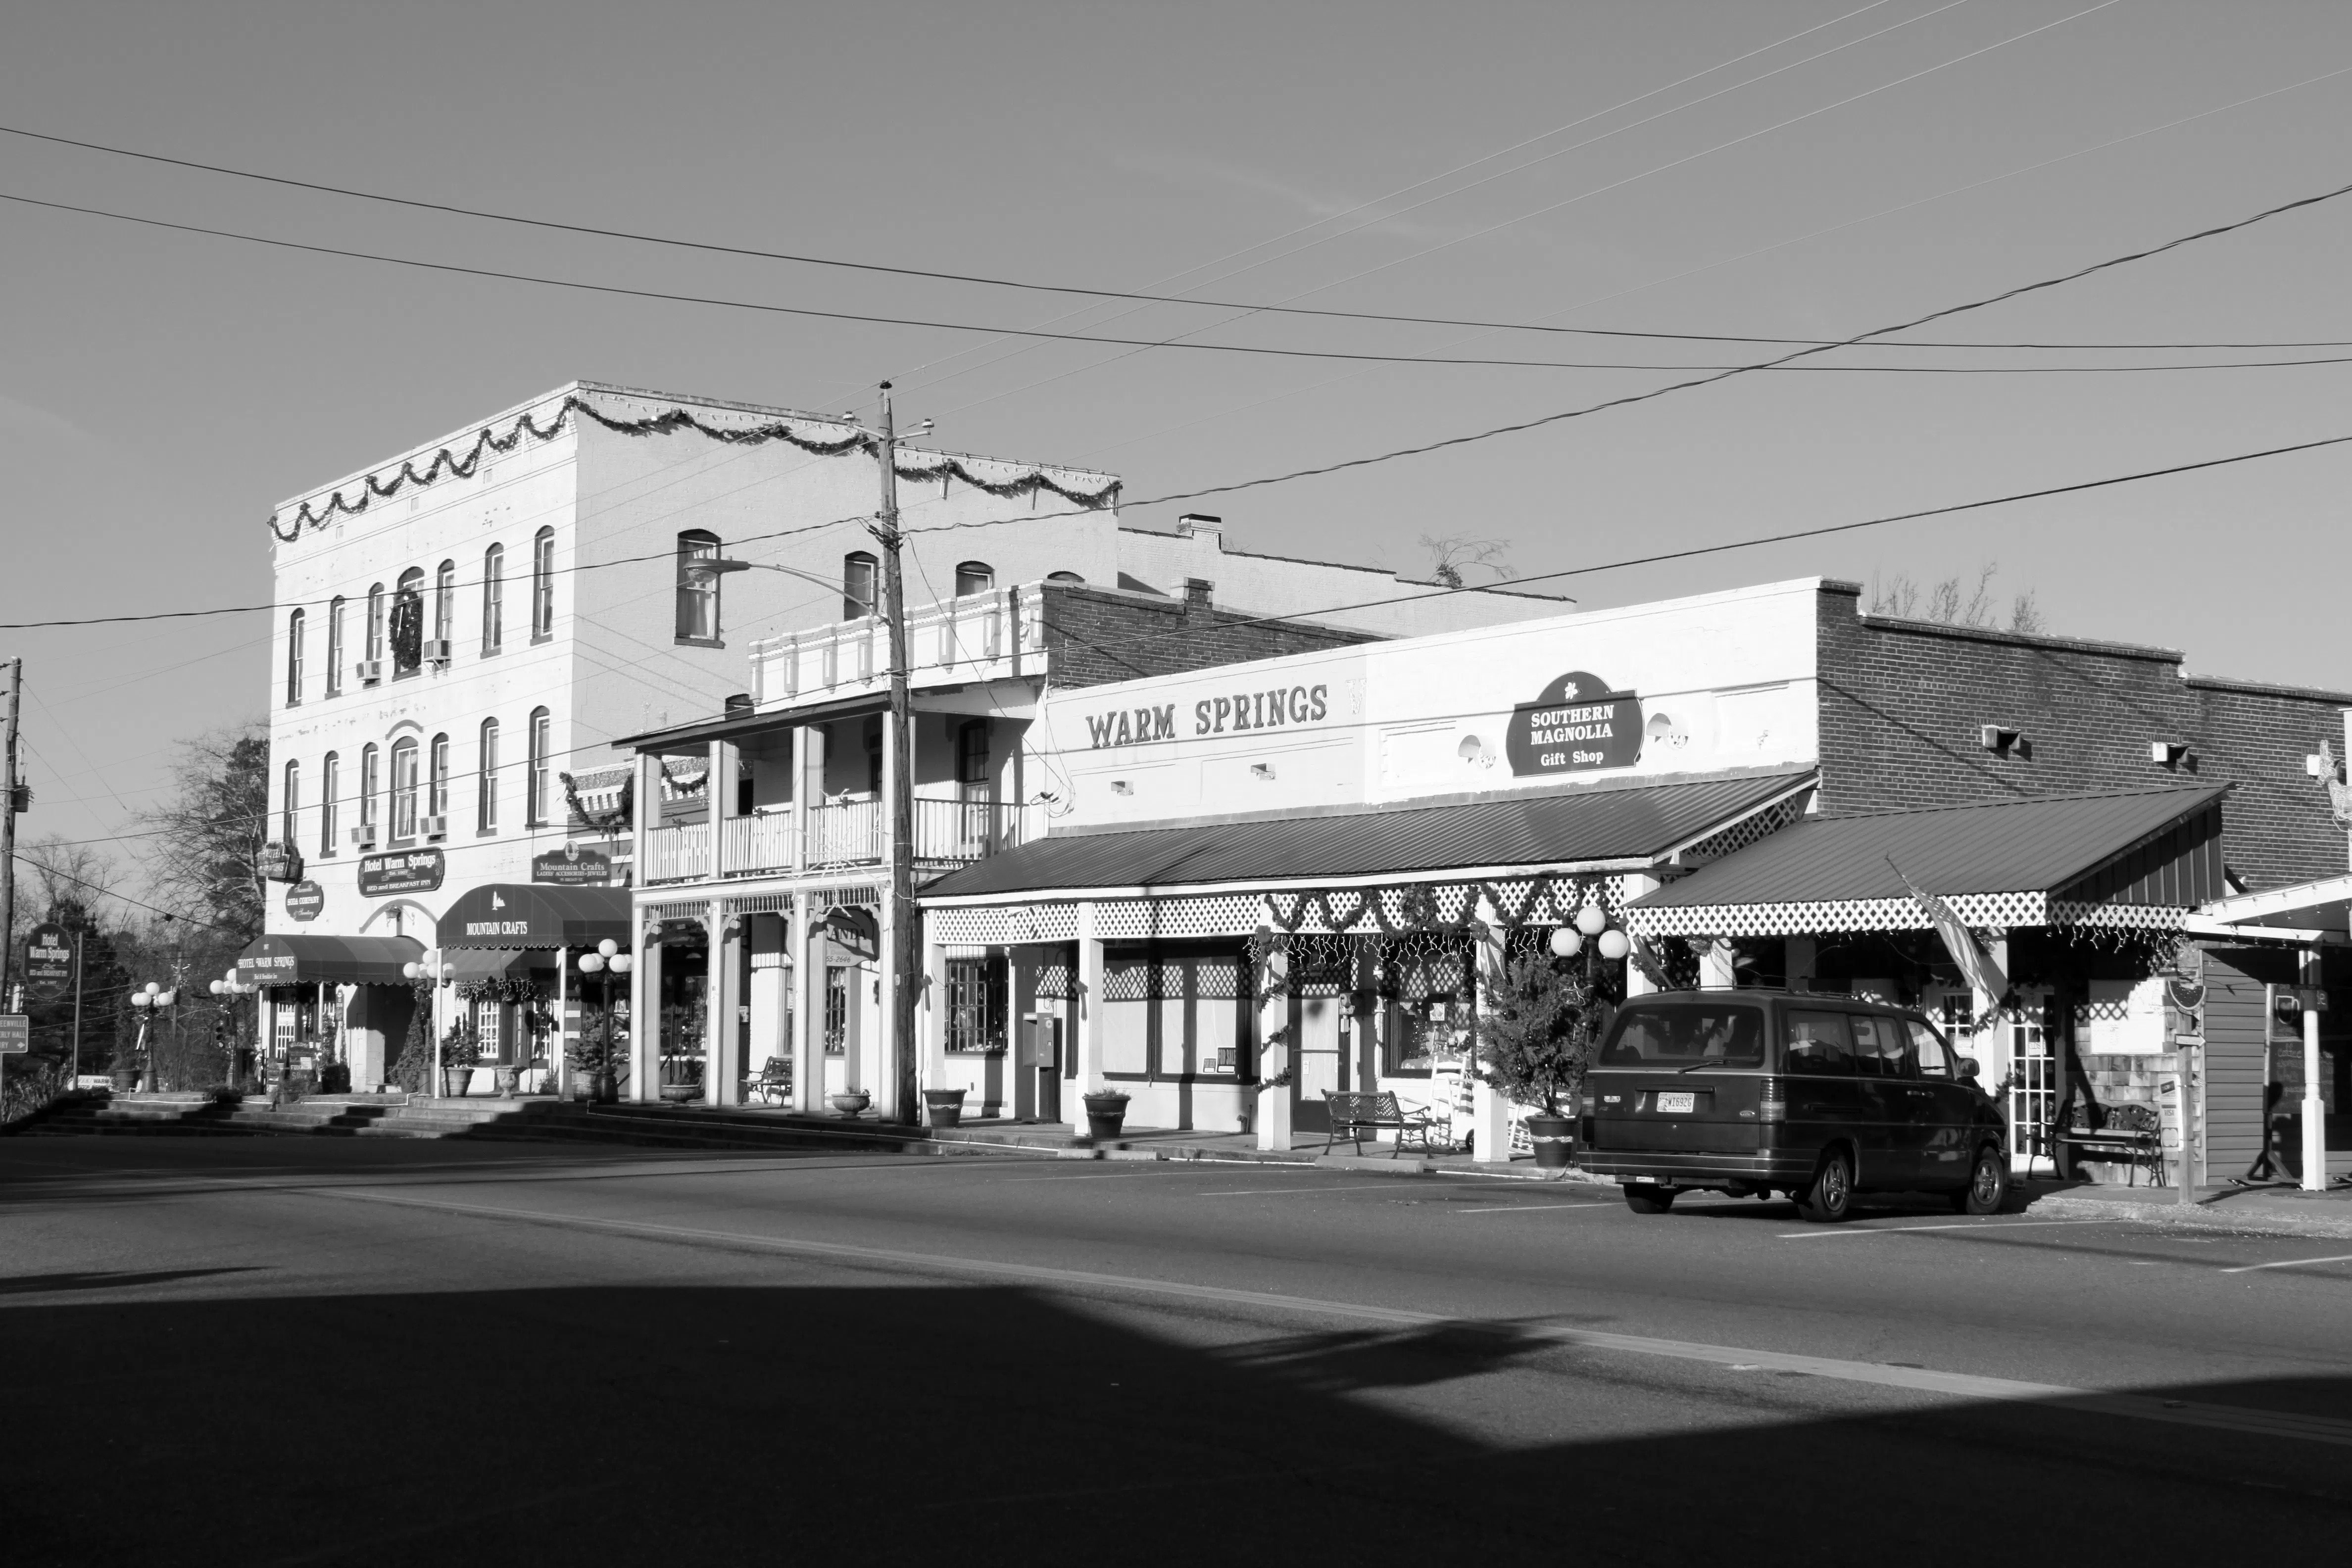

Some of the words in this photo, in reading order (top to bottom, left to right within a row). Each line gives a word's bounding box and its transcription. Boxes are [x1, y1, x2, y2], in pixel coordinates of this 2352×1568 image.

[1085, 703, 1176, 748] WARM
[1195, 684, 1327, 735] SPRINGS
[1531, 705, 1614, 728] SOUTHERN
[1530, 723, 1613, 745] MAGNOLIA
[1541, 752, 1566, 766] Gift
[1572, 750, 1604, 764] Shop
[364, 858, 382, 872] Hotel
[385, 857, 404, 870] Warm
[408, 853, 436, 870] Springs
[581, 862, 604, 871] Crafts
[389, 880, 420, 889] BREAKFAST
[299, 896, 320, 905] COMPANY
[466, 922, 500, 935] MOUNTAIN
[501, 921, 528, 934] CRAFTS
[828, 928, 867, 940] ANDA
[42, 932, 58, 946] Hotel
[30, 946, 47, 958] Warm
[48, 946, 70, 962] Springs
[238, 958, 255, 969] HOTEL
[256, 957, 272, 968] WARM
[274, 956, 294, 970] SPRINGS
